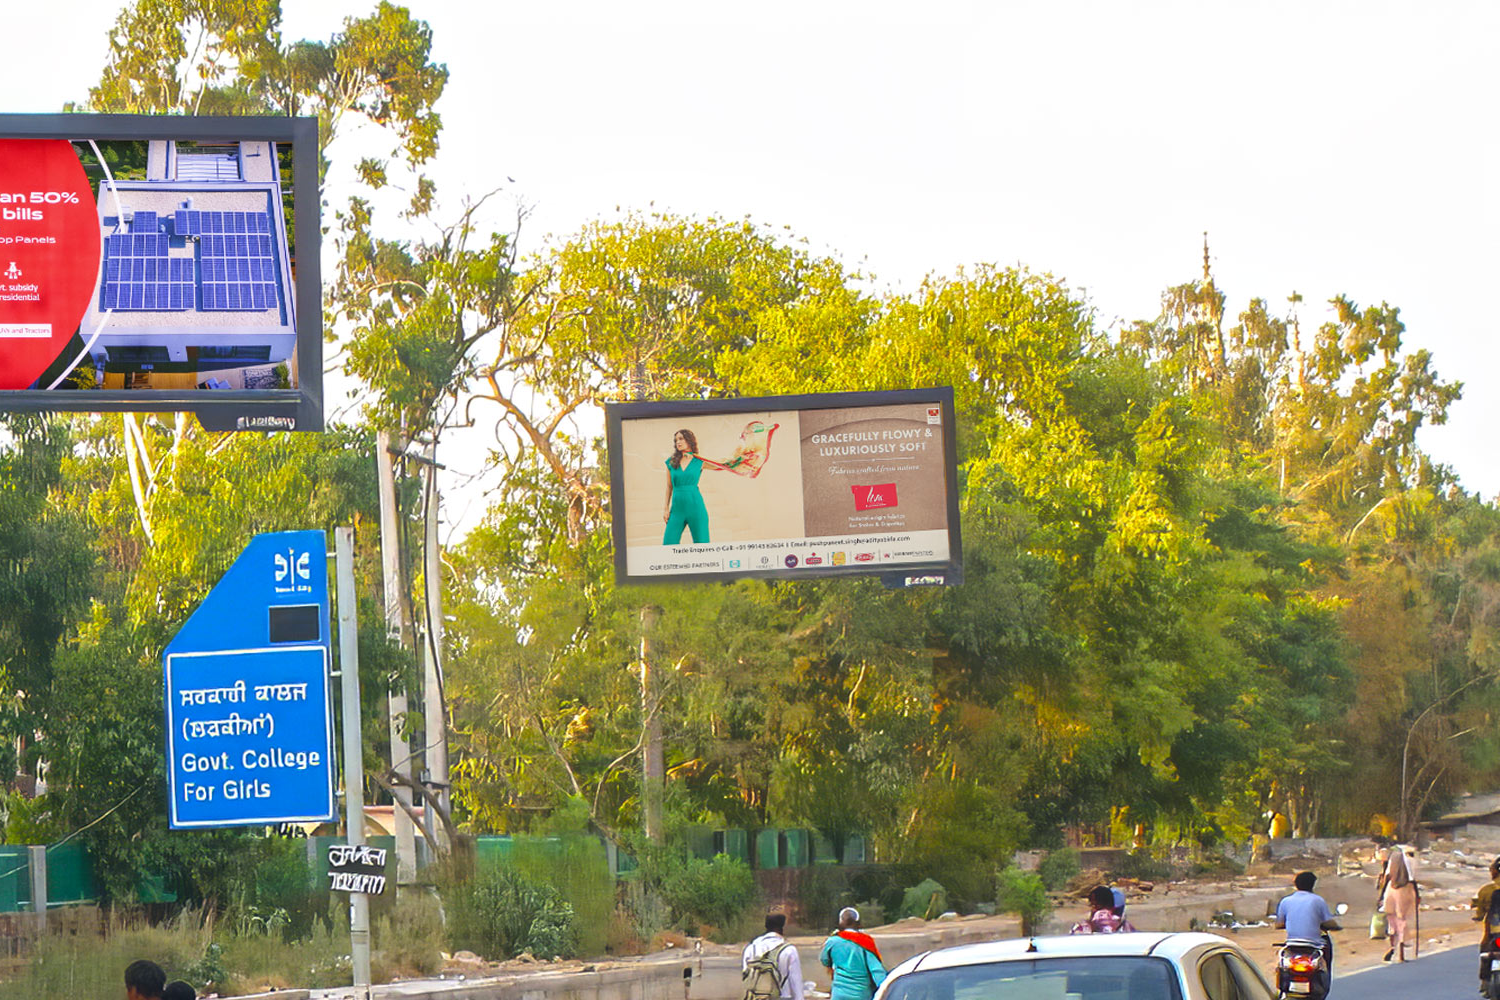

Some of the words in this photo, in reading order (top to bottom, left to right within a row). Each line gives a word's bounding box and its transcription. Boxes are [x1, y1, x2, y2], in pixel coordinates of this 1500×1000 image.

[29, 191, 80, 205] 50%
[2, 207, 44, 221] bills
[15, 236, 56, 245] Panels
[8, 283, 39, 293] subsidy
[811, 430, 880, 444] GRACEFULLY
[882, 428, 922, 440] FLOWY
[924, 427, 933, 438] &
[819, 443, 896, 457] LUXURIOUSLY
[899, 442, 927, 452] SOFT
[179, 680, 246, 707] ਸਰਕਾਰੀ
[253, 683, 308, 701] ਕਾਲਜ
[181, 752, 235, 772] Govt.
[242, 747, 321, 770] College
[184, 782, 215, 802] For
[223, 778, 271, 800] Girls
